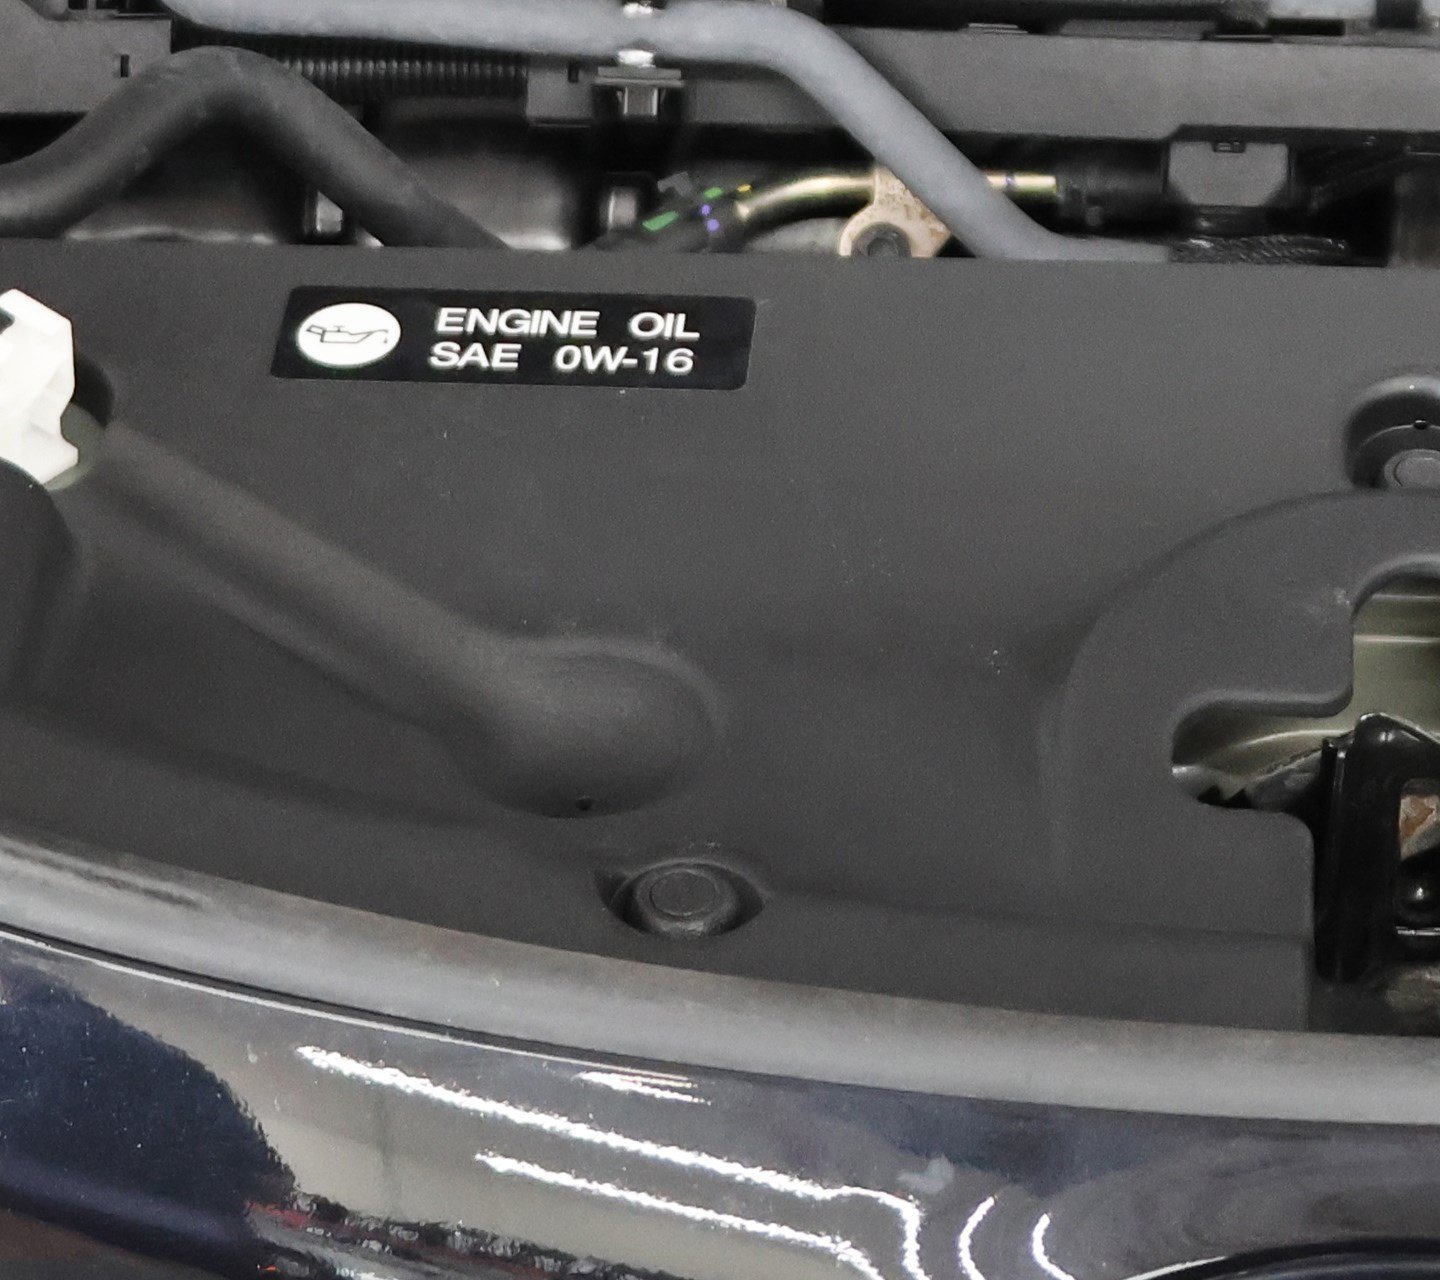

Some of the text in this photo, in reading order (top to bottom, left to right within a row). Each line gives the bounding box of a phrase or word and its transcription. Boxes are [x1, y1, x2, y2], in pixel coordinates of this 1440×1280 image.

[436, 307, 700, 340] ENGINE OIL
[429, 342, 694, 376] SAE 0W-16
